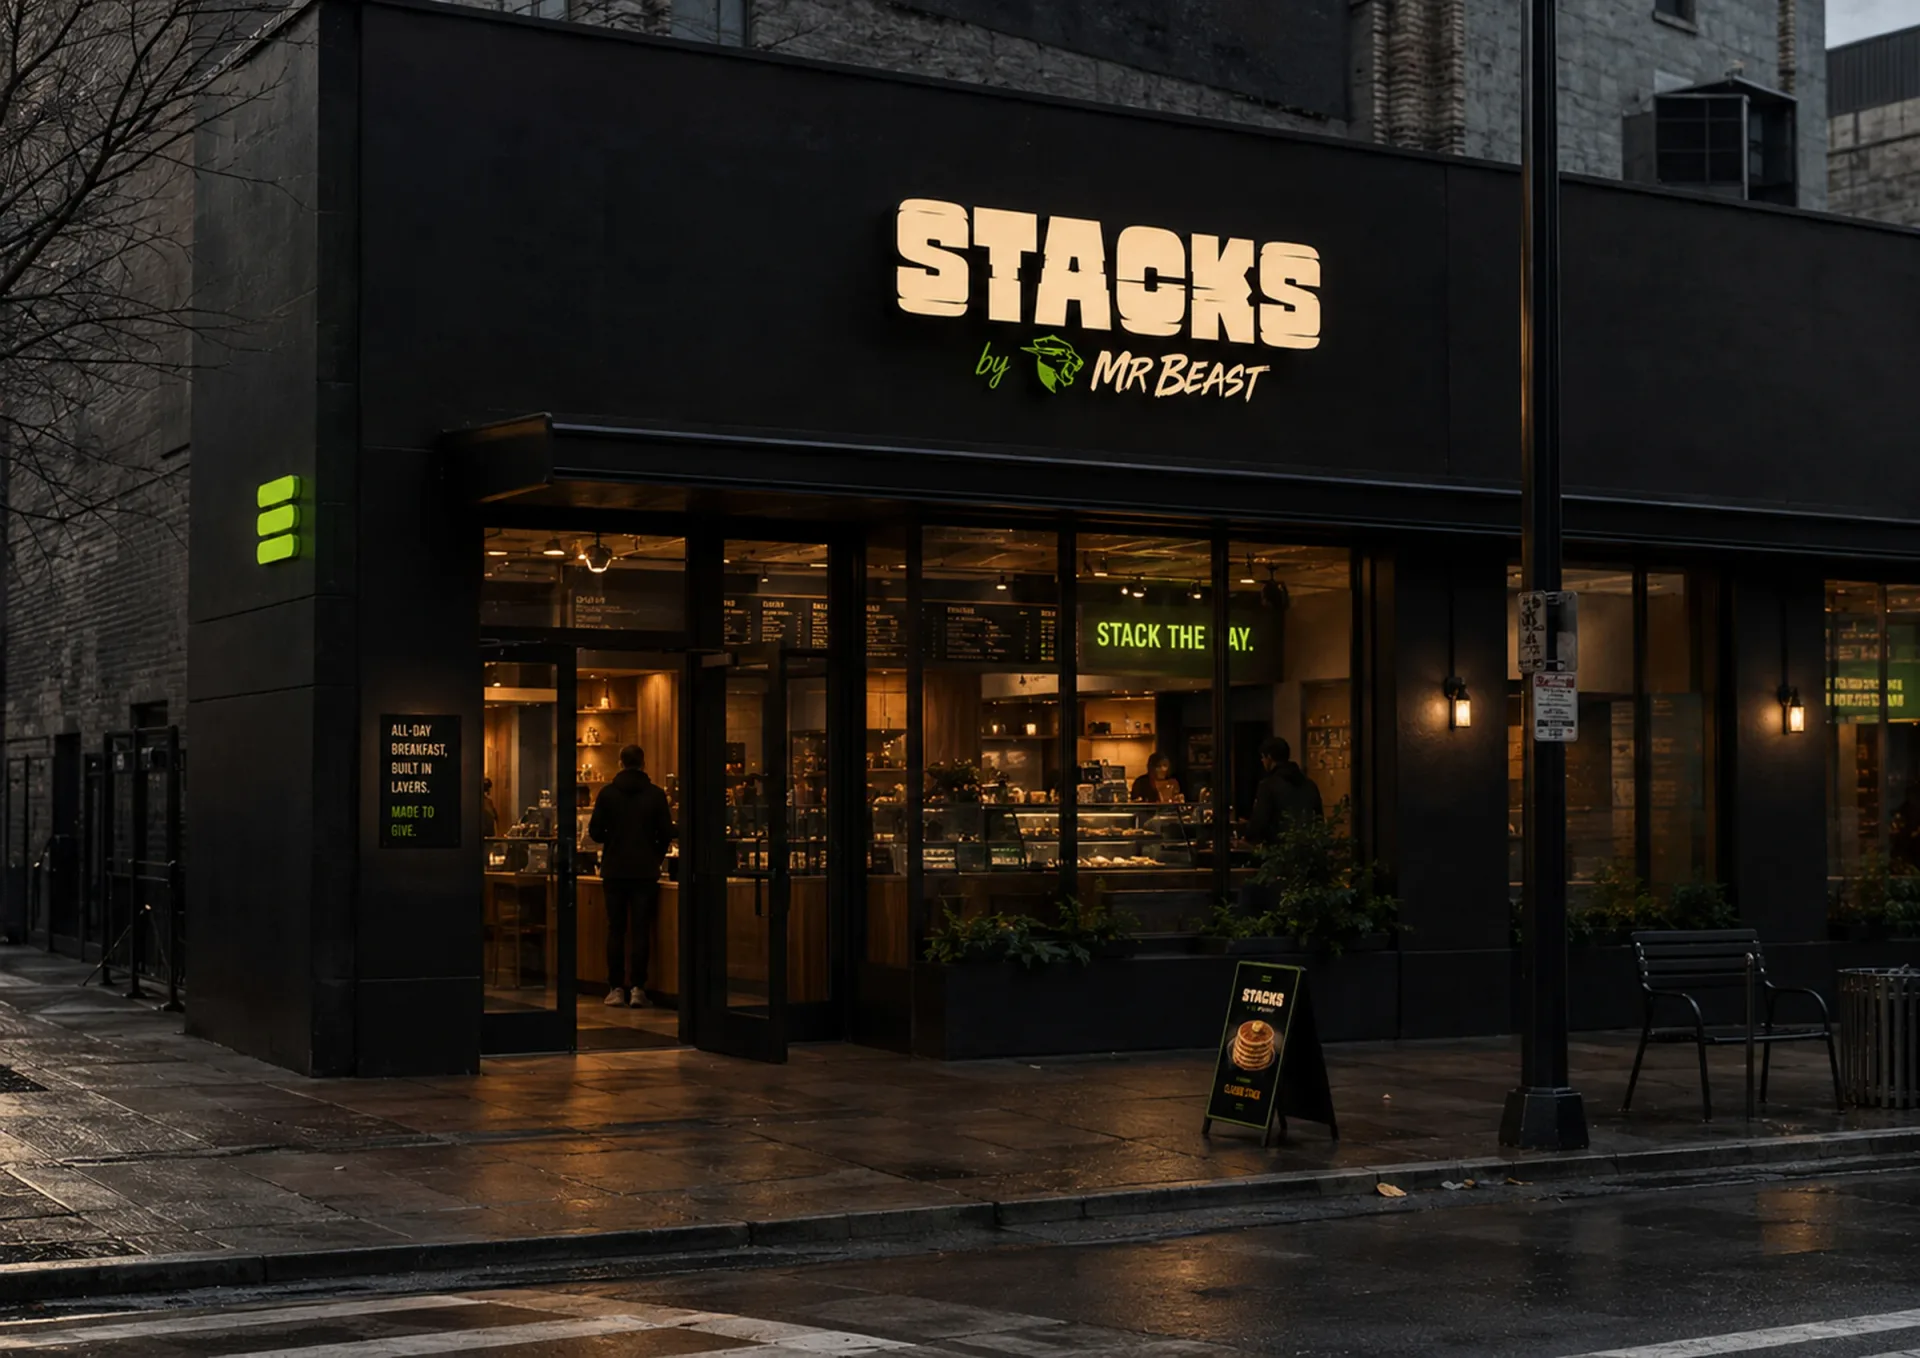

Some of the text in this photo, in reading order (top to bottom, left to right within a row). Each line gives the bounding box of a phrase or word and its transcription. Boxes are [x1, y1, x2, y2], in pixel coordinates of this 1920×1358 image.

[896, 198, 1321, 350] STACKS
[975, 341, 1011, 389] by
[1097, 621, 1254, 652] STACK THE AY.
[391, 724, 432, 737] ALL-DAY
[391, 743, 448, 758] BREAKFAST,
[391, 762, 432, 775] BUILT IN
[391, 781, 430, 793] LAYERS.
[391, 805, 435, 818] MADE TO
[391, 824, 417, 837] GIVE.
[1242, 988, 1284, 1007] STACKS
